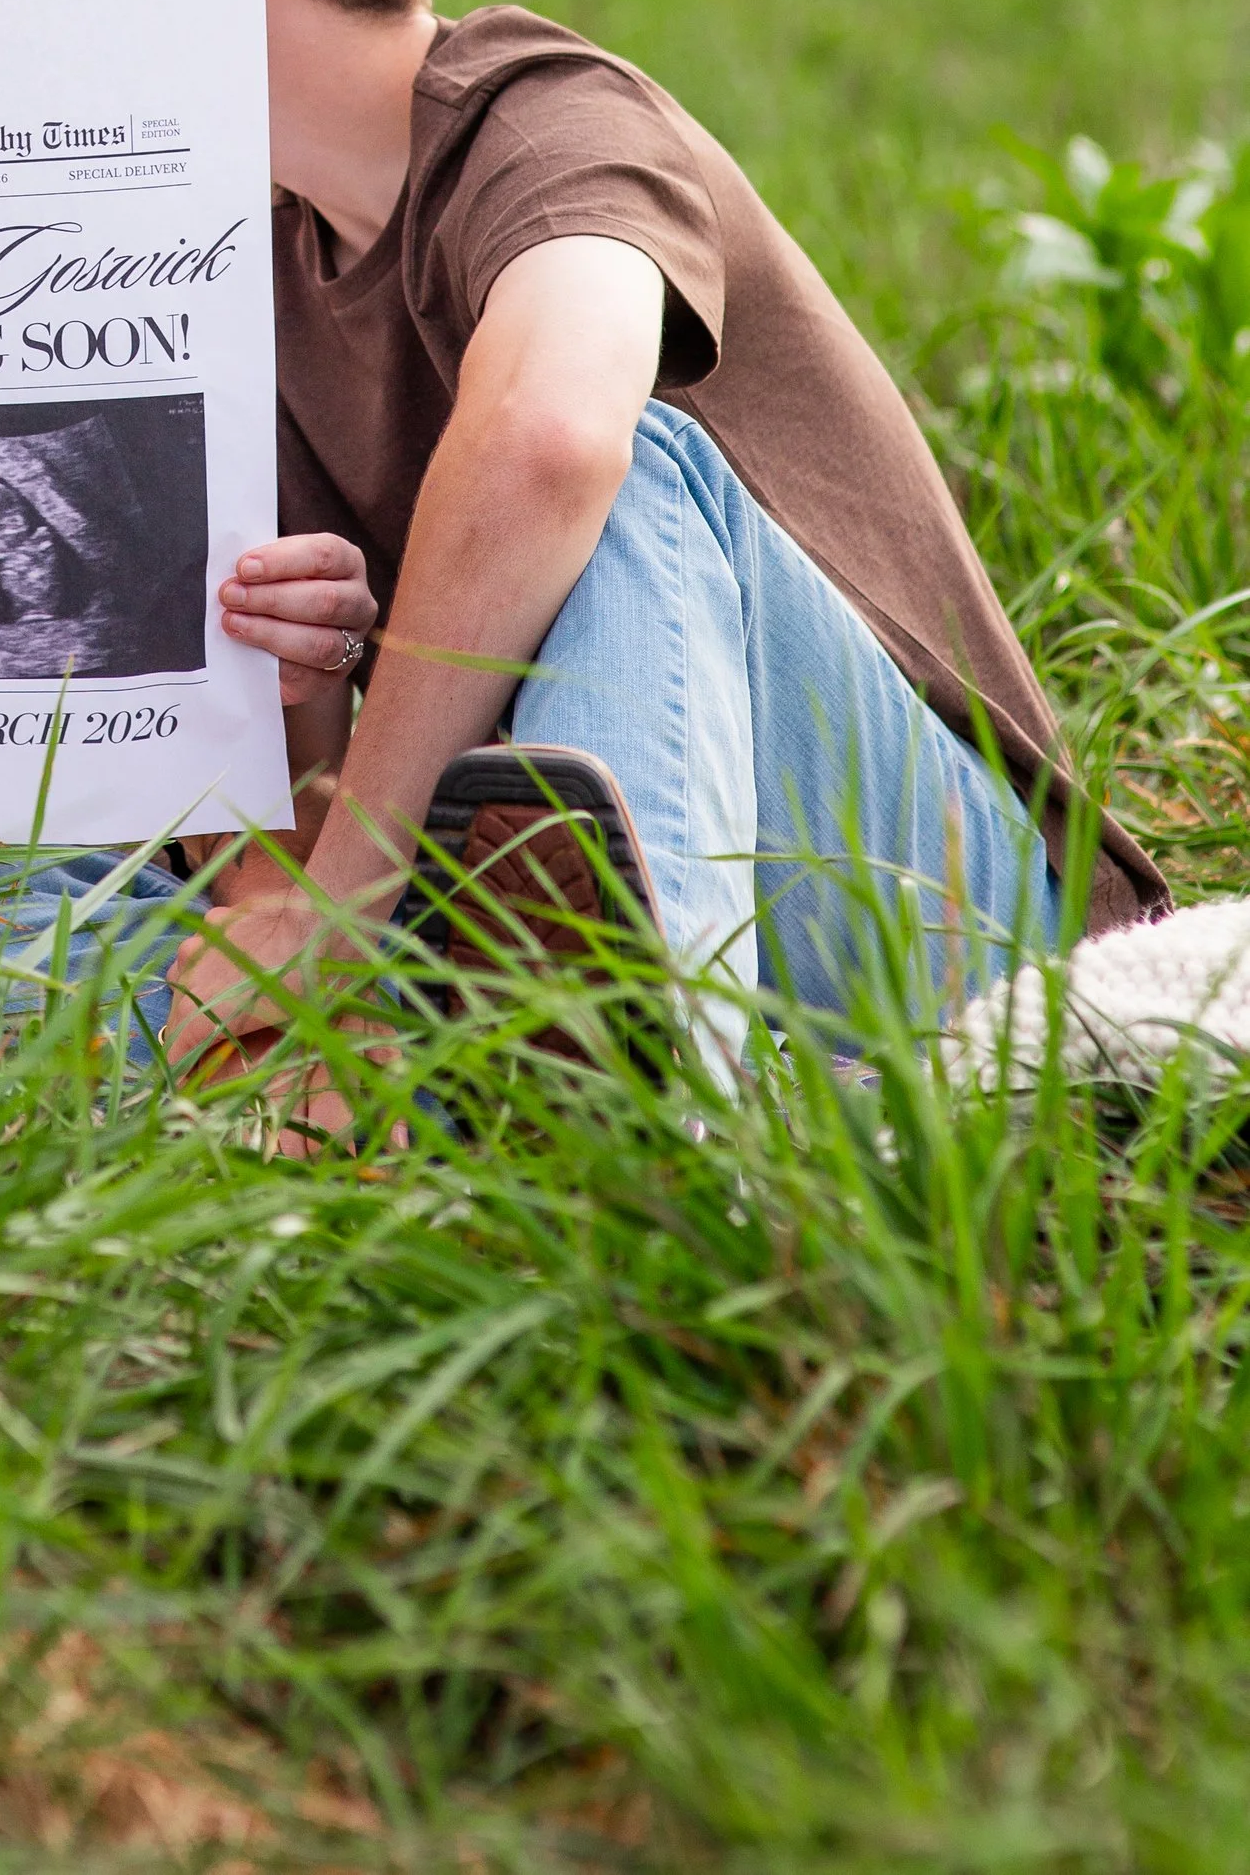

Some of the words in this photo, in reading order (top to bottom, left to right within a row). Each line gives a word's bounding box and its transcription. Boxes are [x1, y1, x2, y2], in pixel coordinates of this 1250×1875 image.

[42, 121, 126, 150] Times
[141, 128, 181, 139] EDITION
[142, 118, 179, 129] SPECIAL
[68, 169, 122, 181] SPECIAL
[125, 162, 187, 177] DELIVERY
[22, 313, 191, 372] SOON!
[82, 703, 181, 746] 2026
